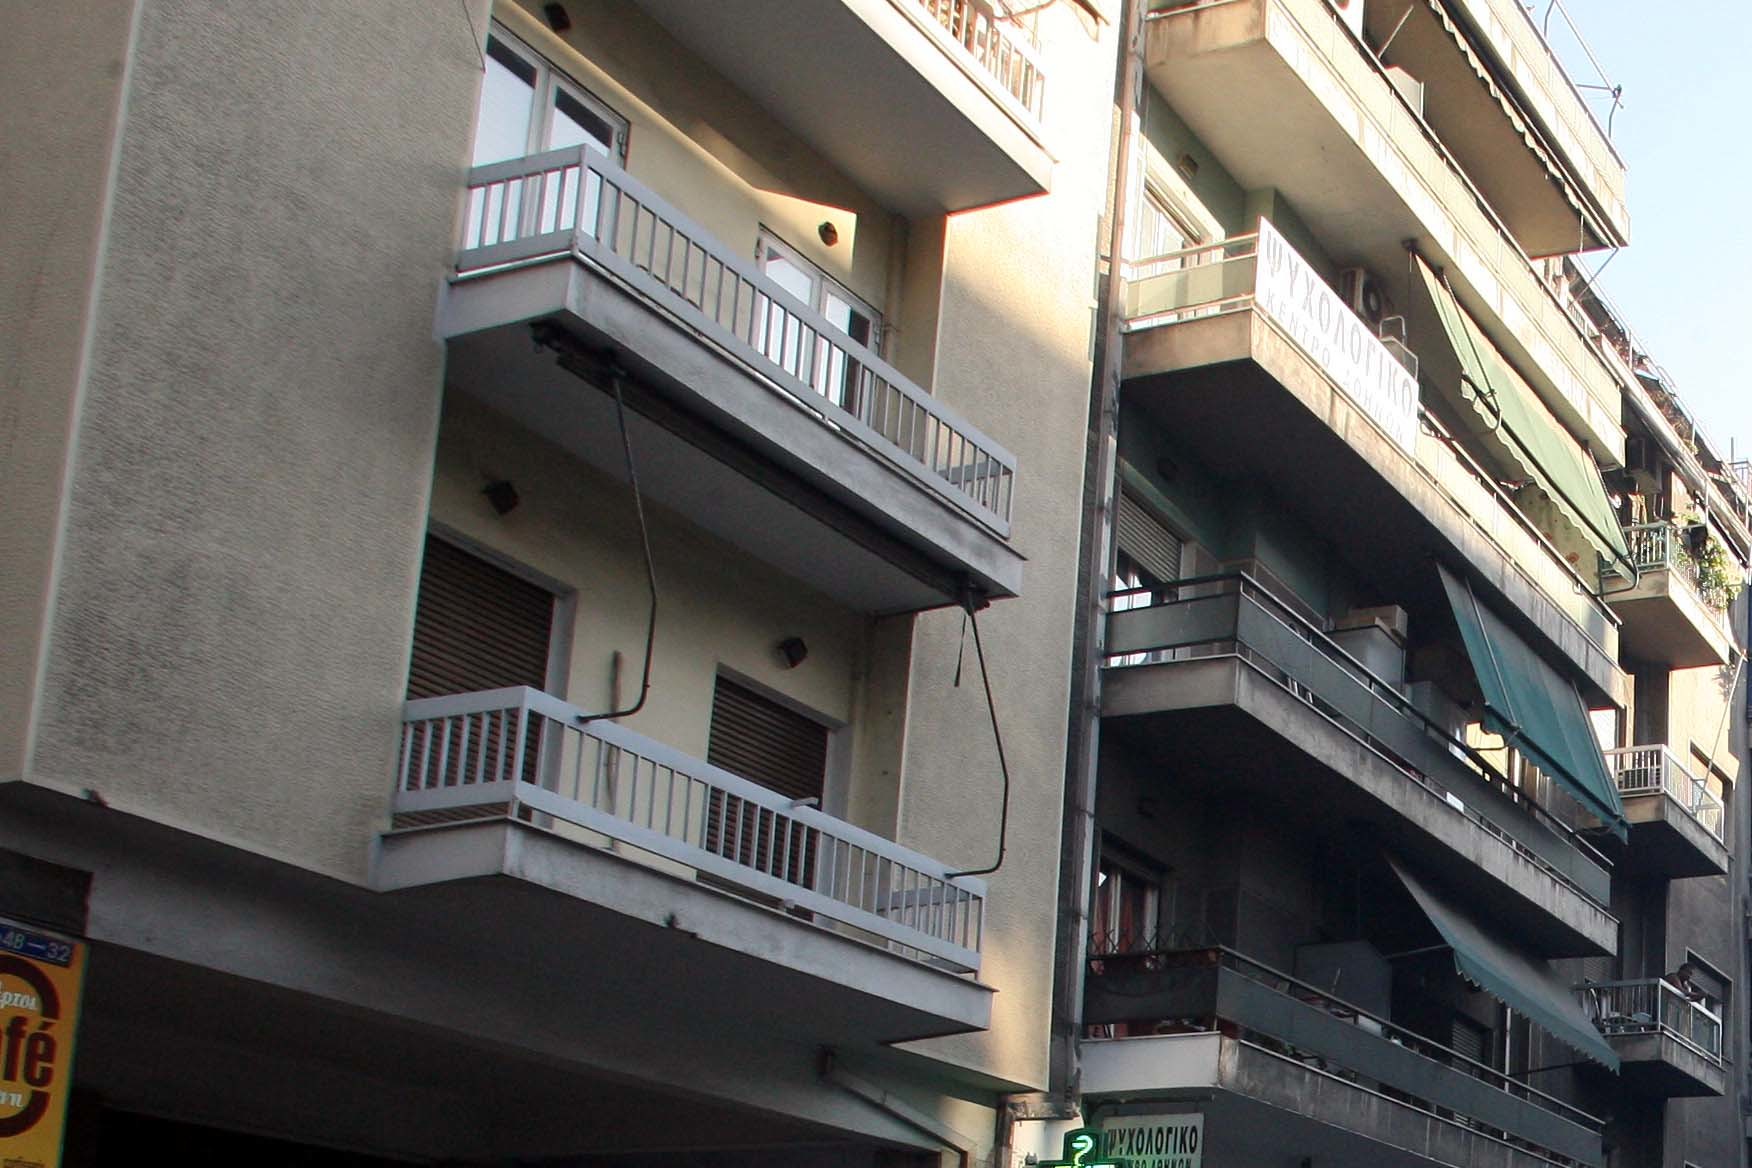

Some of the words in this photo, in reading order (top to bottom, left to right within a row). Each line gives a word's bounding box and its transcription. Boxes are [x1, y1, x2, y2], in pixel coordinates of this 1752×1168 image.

[1265, 229, 1413, 418] ΨΥΧΟΛΟΓΙΚΟ
[0, 1015, 57, 1088] fé
[1109, 1125, 1199, 1156] ΨΥΧΟΛΟΓΙΚΟ
